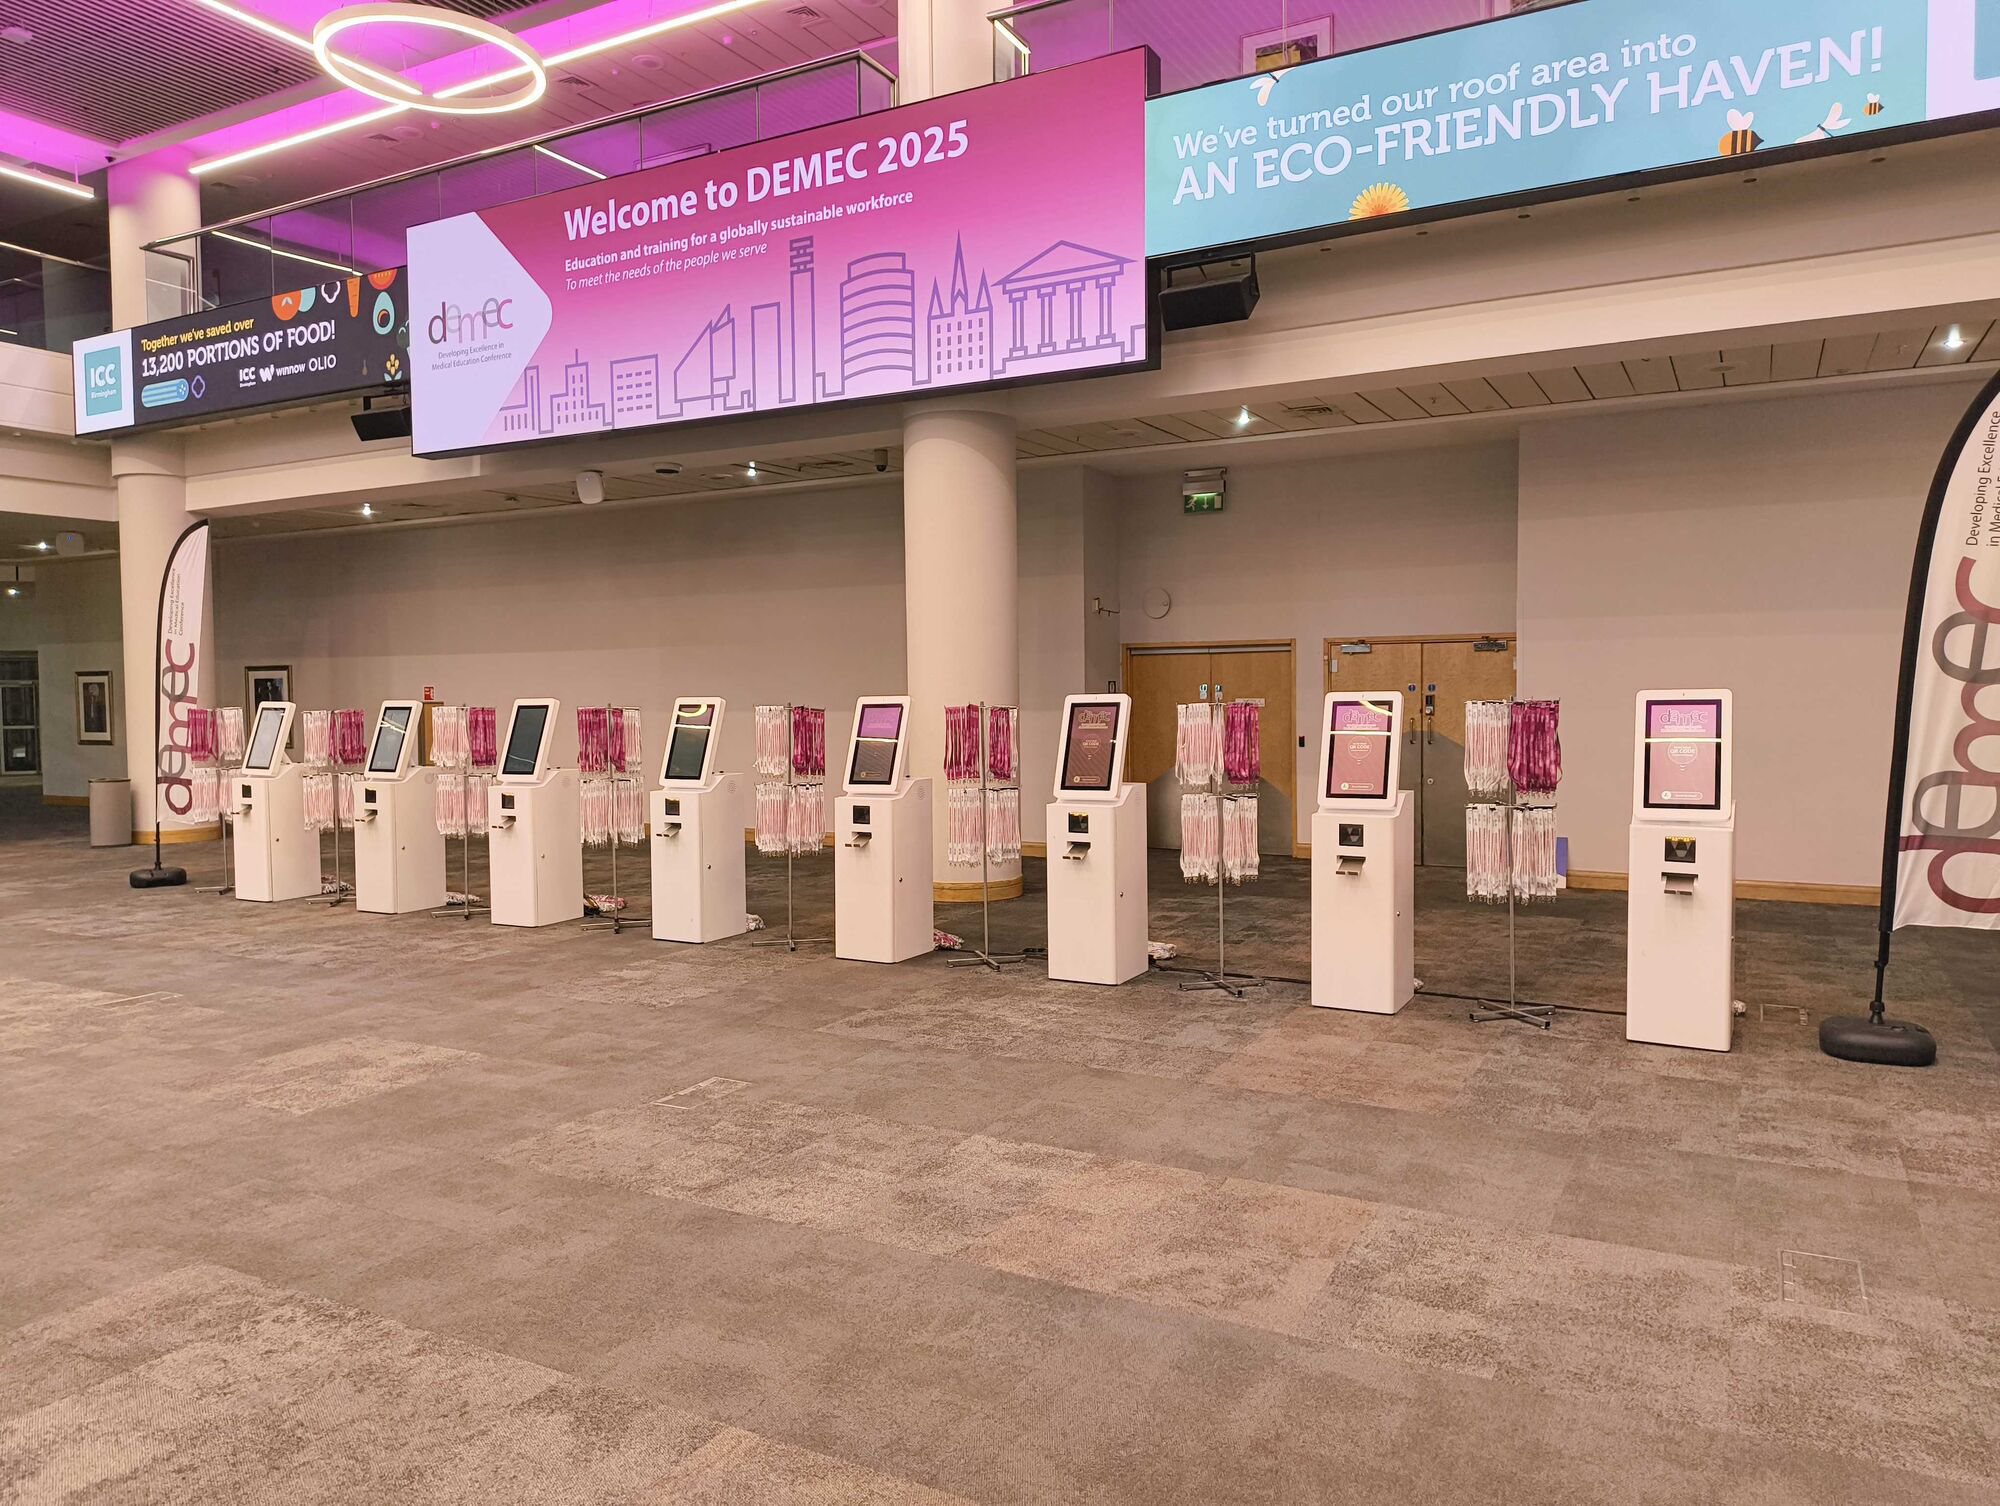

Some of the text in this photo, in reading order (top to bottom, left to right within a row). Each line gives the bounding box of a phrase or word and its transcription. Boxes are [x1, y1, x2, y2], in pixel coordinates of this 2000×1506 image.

[1172, 26, 1883, 206] AN ECO-FRIENDLY HAVEN!
[1173, 33, 1697, 160] We've turned our roof area into
[564, 119, 969, 241] Welcome to DEMEC 2025
[565, 190, 913, 272] Education and training for a globally sustainable workforce
[566, 242, 767, 291] To meet the needs of the people we serve
[141, 319, 254, 352] Together we've saved over
[428, 298, 513, 344] demec
[142, 320, 335, 377] 13,200 PORTIONS OF FOOD!
[240, 367, 256, 381] ICC
[276, 363, 305, 376] winnow
[308, 354, 336, 372] OLIO
[432, 352, 512, 371] Medical Education Conference
[438, 347, 468, 359] Developing
[470, 343, 497, 354] Excellence
[90, 363, 116, 388] ICC
[1966, 411, 2000, 546] Developing Excellence
[1986, 536, 1999, 546] in
[157, 639, 197, 815] demec
